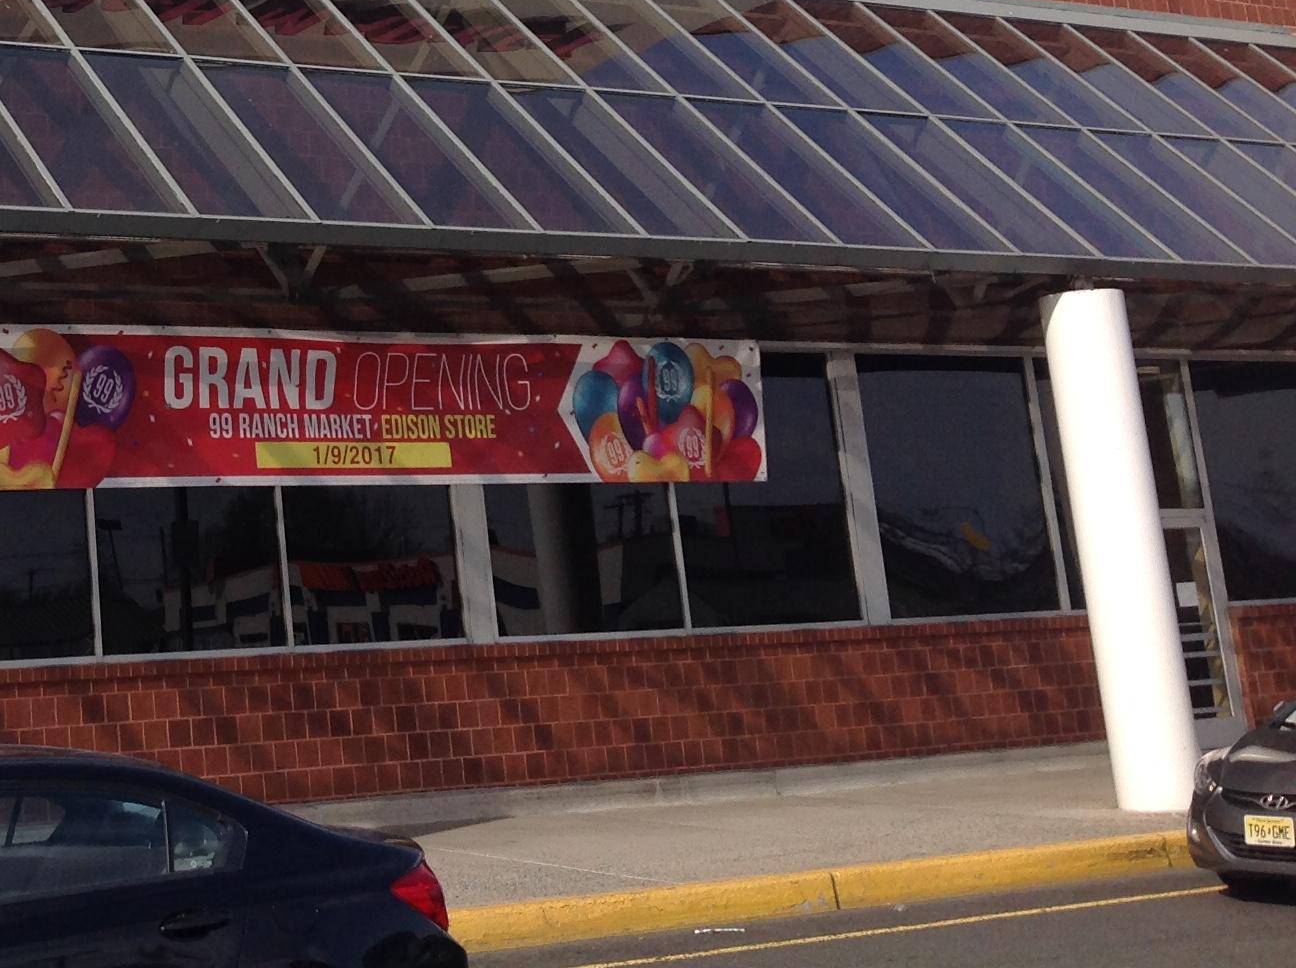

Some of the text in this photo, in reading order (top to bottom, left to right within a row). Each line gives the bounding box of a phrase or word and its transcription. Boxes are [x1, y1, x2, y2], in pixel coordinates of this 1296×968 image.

[93, 374, 115, 403] 99
[163, 345, 531, 411] GRAND OPENING
[209, 413, 497, 439] 99 RANCH MARKET EDISON STORE
[312, 444, 397, 466] 1/9/2017
